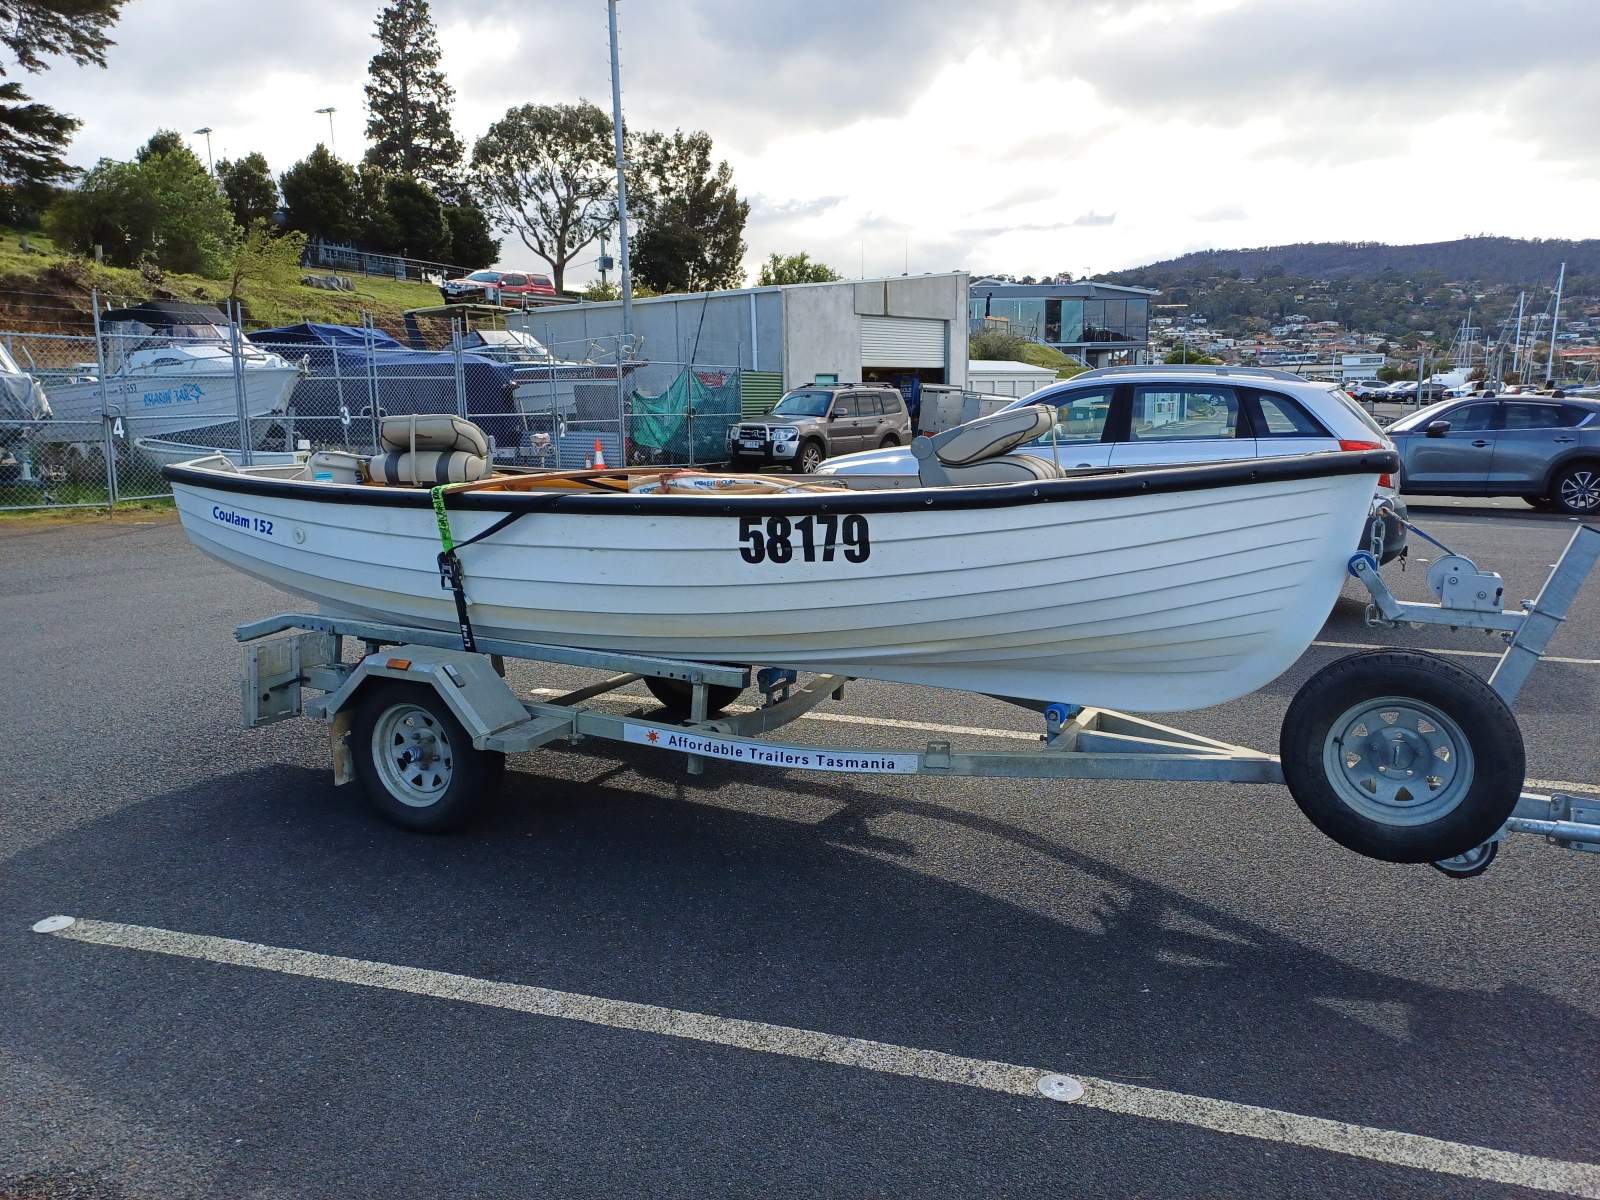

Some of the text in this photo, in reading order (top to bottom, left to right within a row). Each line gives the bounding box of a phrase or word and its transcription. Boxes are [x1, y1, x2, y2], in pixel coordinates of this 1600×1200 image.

[113, 417, 125, 438] 4
[340, 406, 350, 424] 3
[213, 506, 273, 536] Coulam 152
[738, 513, 871, 564] 58179
[668, 735, 896, 770] Affordable Trailers Tasmania
